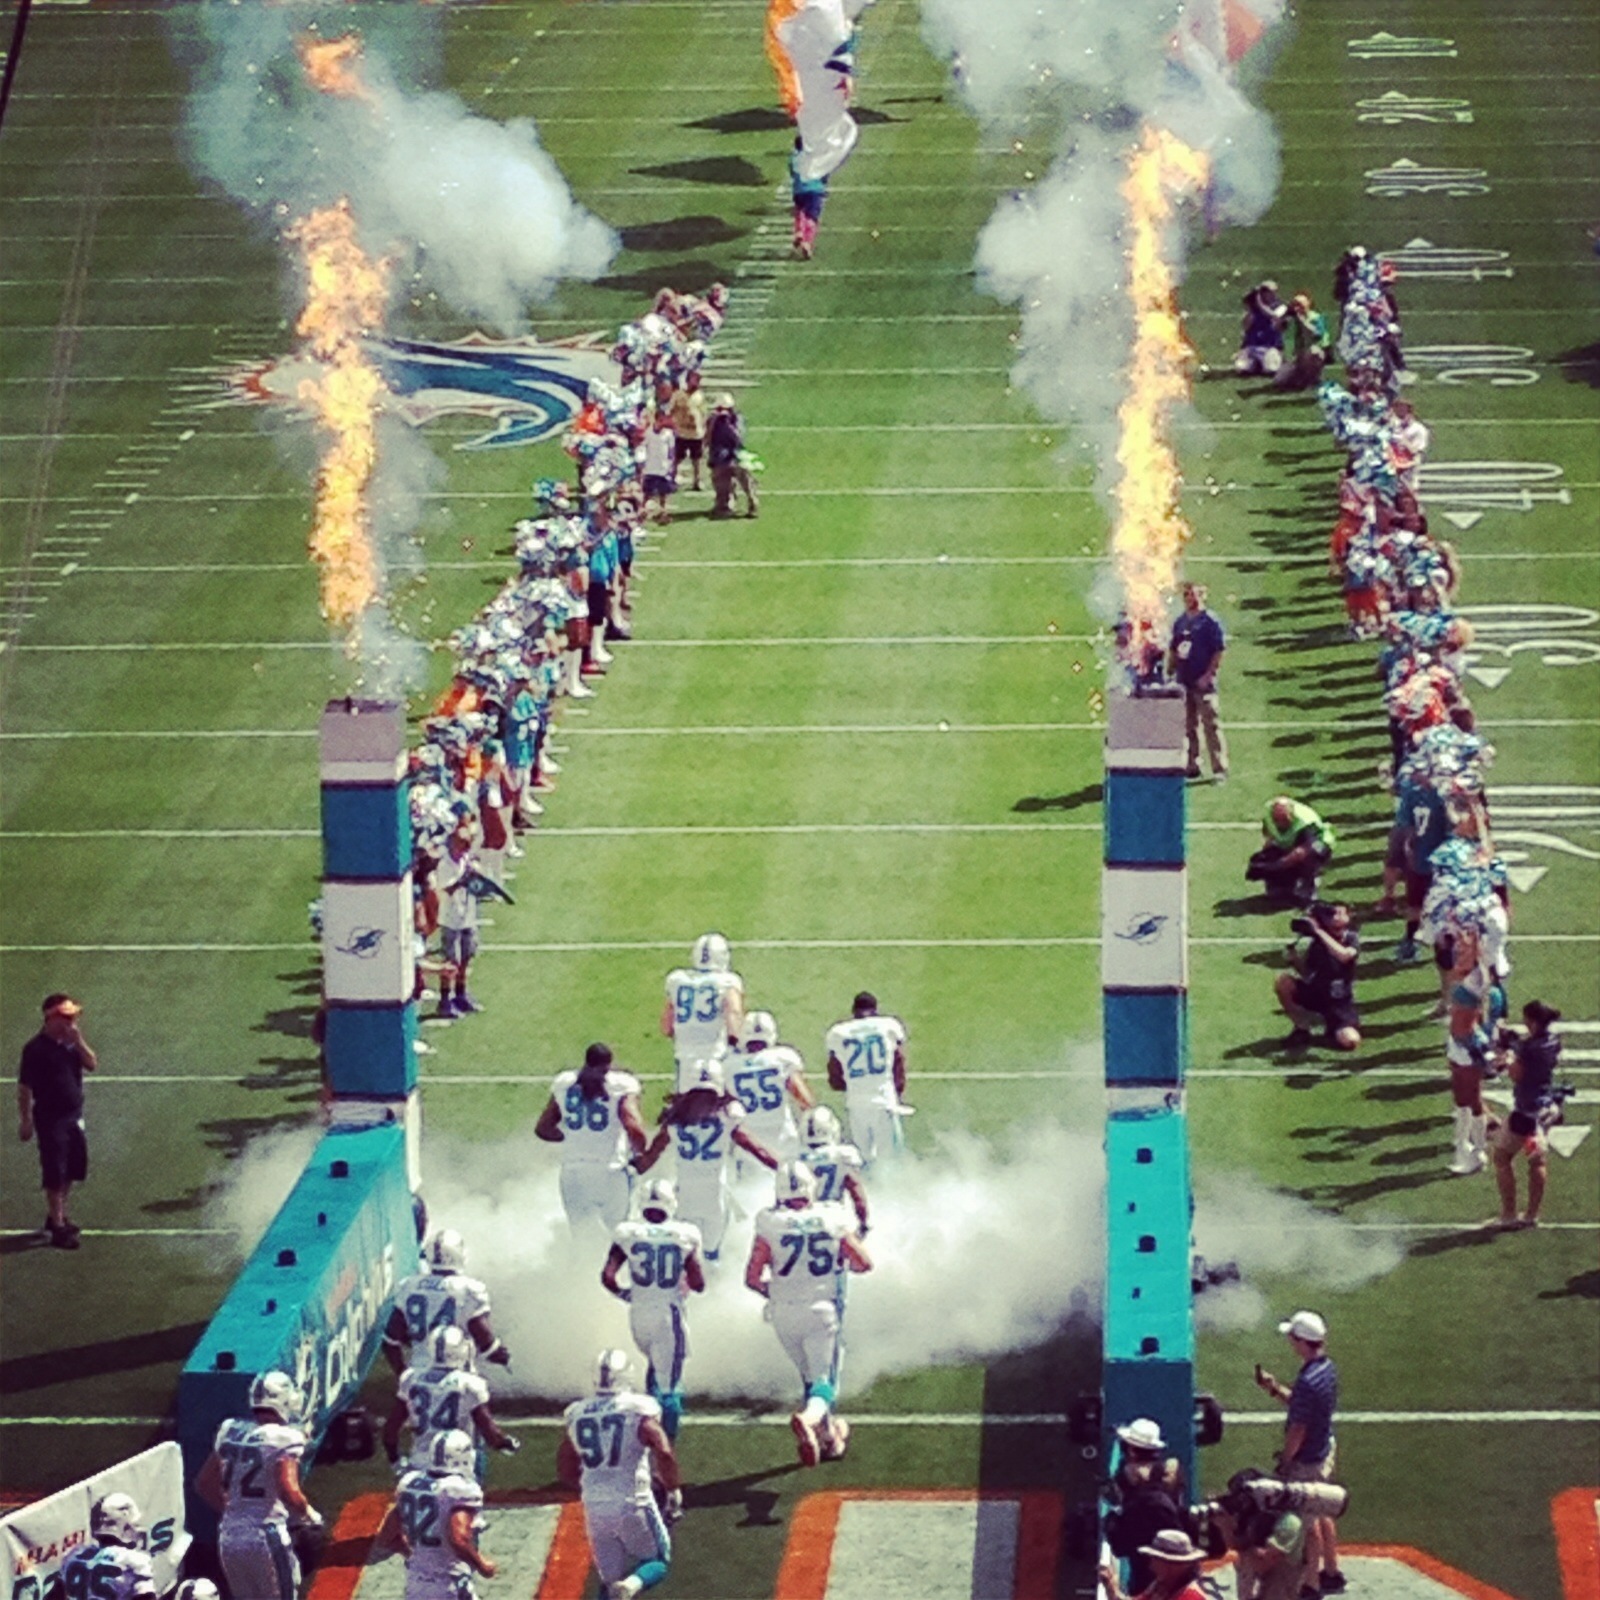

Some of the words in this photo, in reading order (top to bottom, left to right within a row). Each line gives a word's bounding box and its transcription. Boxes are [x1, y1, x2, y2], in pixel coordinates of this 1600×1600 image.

[1355, 98, 1475, 123] 20
[1364, 167, 1491, 197] 30
[1375, 249, 1514, 281] 40
[1393, 345, 1540, 386] 50
[1415, 461, 1571, 511] 40
[675, 985, 720, 1023] 93
[843, 1034, 887, 1077] 20
[565, 1085, 609, 1131] 96
[734, 1068, 783, 1112] 55
[677, 1117, 723, 1160] 52
[630, 1242, 682, 1288] 30
[779, 1231, 833, 1277] 75
[406, 1294, 456, 1341] 94
[409, 1384, 461, 1436] 34
[576, 1413, 626, 1469] 97
[400, 1491, 442, 1546] 92
